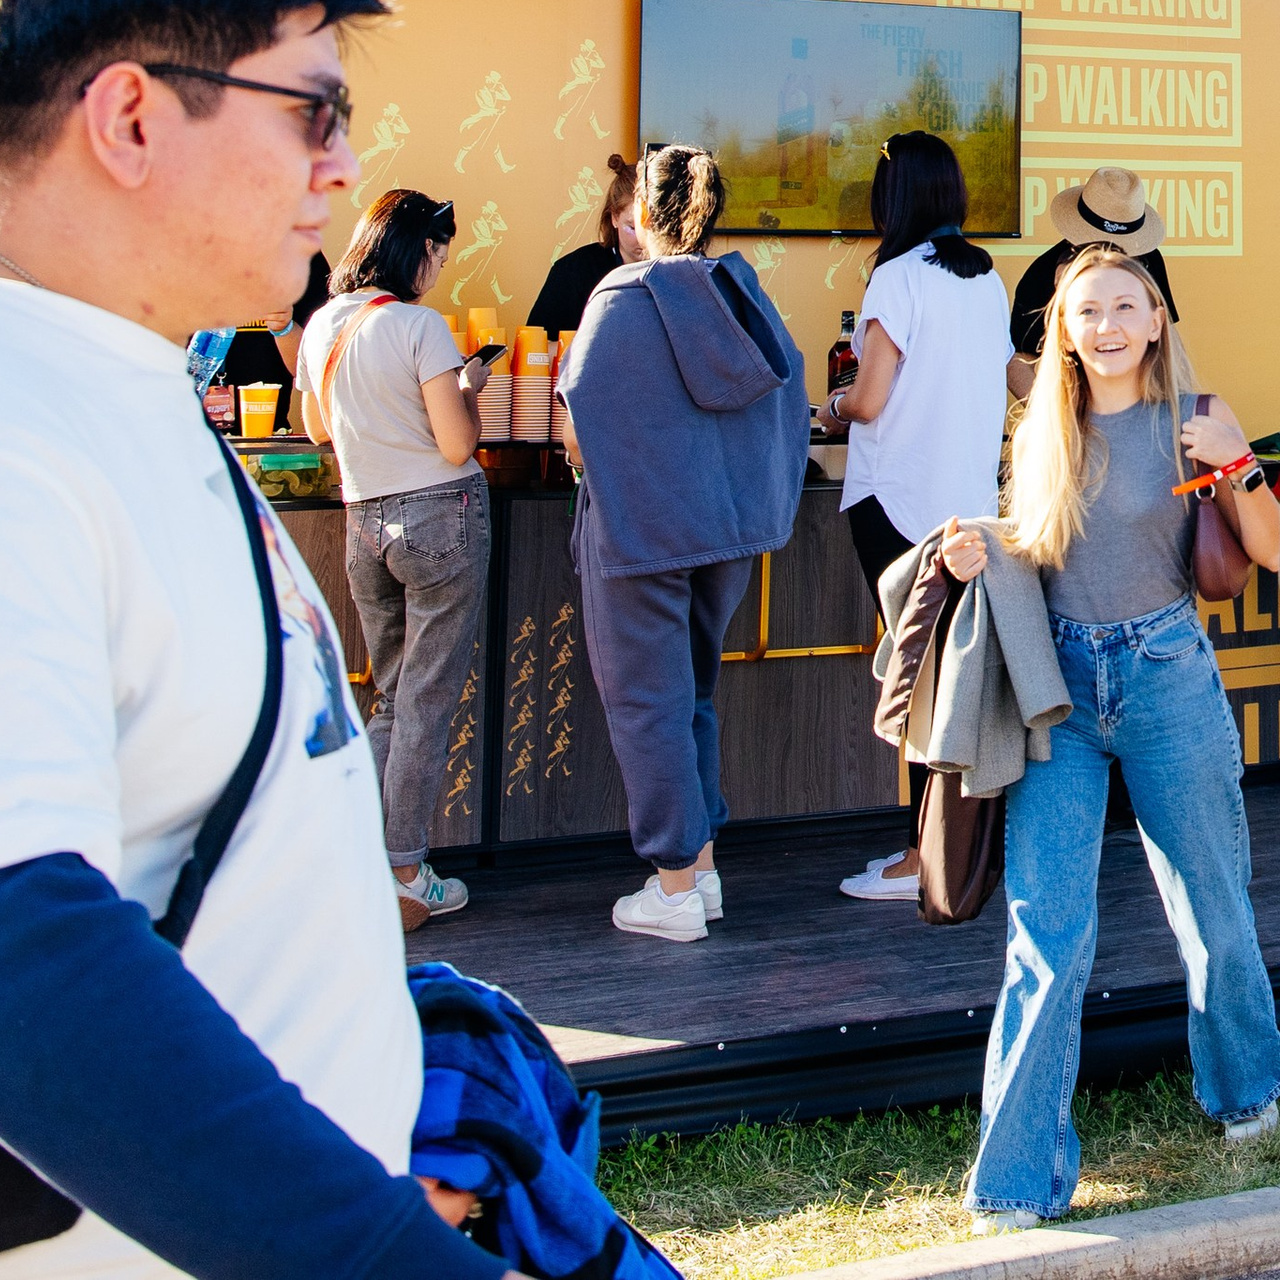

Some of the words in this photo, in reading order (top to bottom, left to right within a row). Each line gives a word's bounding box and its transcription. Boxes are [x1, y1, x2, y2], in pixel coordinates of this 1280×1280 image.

[860, 23, 881, 40] THE
[882, 24, 926, 48] FIERY
[896, 49, 963, 78] FRESH
[918, 78, 985, 102] JOHNNIE
[1056, 64, 1228, 129] WALKING
[928, 101, 1005, 133] GINGER
